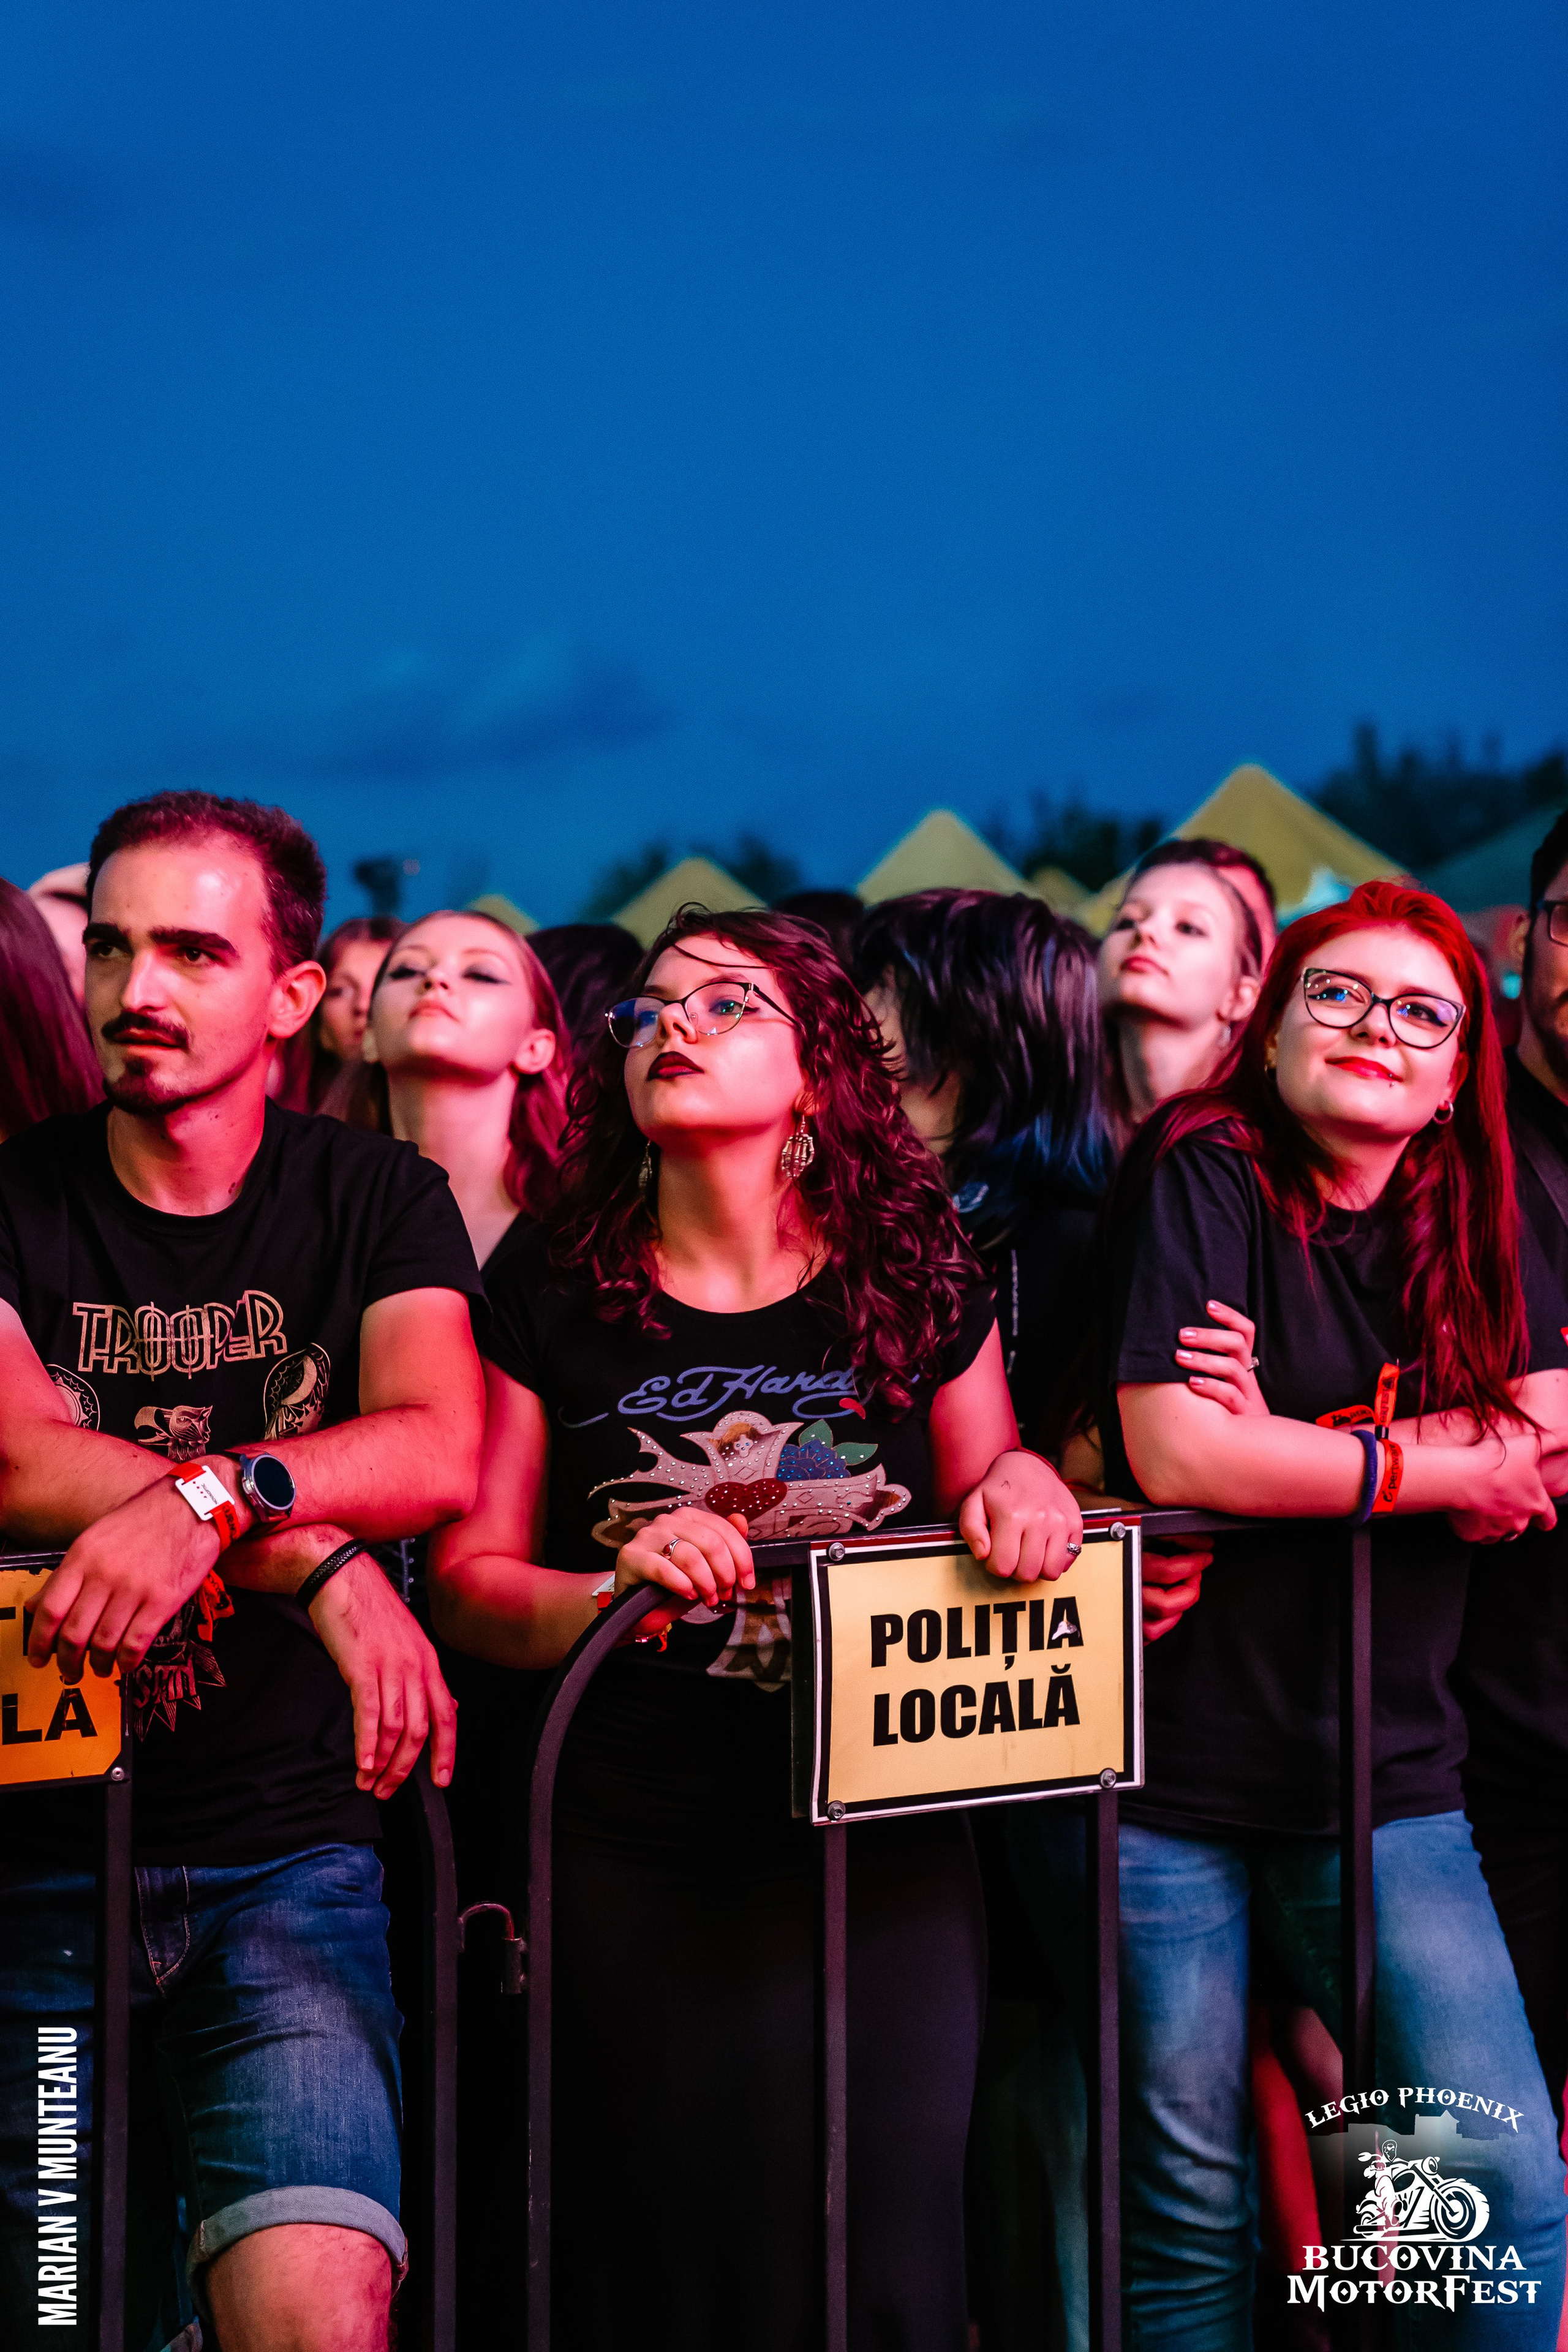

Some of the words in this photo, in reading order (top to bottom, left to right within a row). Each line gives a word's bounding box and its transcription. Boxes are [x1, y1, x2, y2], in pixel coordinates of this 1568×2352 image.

[73, 1290, 288, 1382] TROOPER
[617, 1373, 714, 1414] Ed
[873, 1664, 1080, 1747] LOCALĂ
